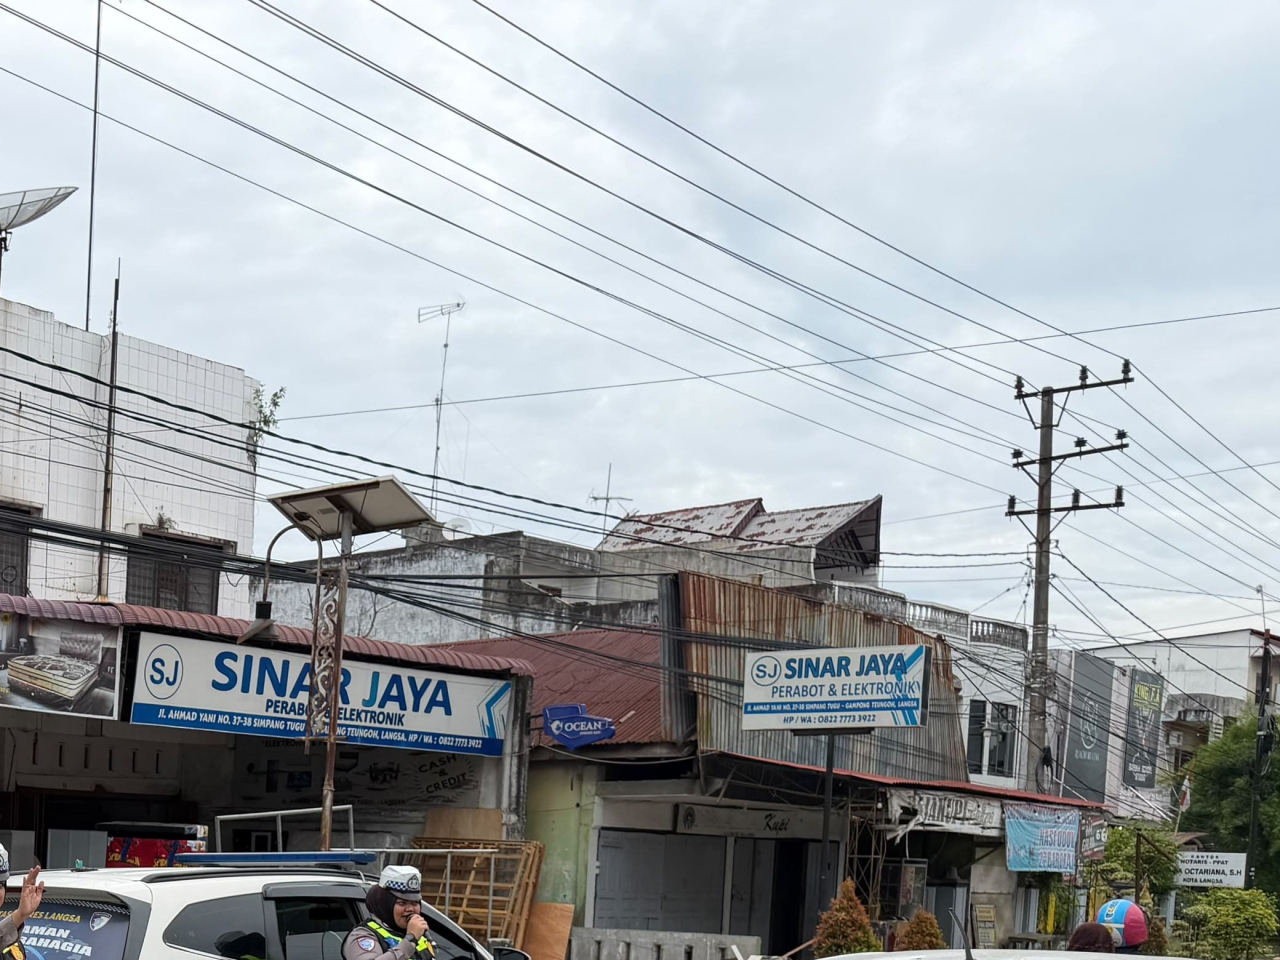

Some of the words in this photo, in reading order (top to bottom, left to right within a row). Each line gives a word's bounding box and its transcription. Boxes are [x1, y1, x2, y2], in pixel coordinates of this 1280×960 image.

[149, 657, 180, 687] SJ
[755, 663, 778, 679] SJ
[784, 655, 851, 680] SINAR
[855, 653, 908, 677] JAYA
[362, 671, 453, 716] JAYA
[771, 684, 825, 699] PERABOT
[828, 683, 837, 697] &
[841, 681, 916, 696] ELEKTRONIK
[168, 710, 197, 722] AHMAD
[199, 712, 216, 723] YANI
[217, 714, 231, 725] NO.
[232, 716, 252, 726] 37-38
[253, 718, 285, 730] SIMPANG
[286, 721, 306, 731] TUGU
[338, 707, 405, 726] ELEKTRONIK
[783, 716, 794, 724] HP
[800, 715, 812, 724] WA
[818, 715, 837, 723] 0822
[839, 714, 856, 723] 7773
[857, 714, 876, 722] 3922
[347, 727, 380, 740] TEUNGOH,
[423, 734, 433, 744] WA
[565, 721, 602, 732] OCEAN
[419, 753, 457, 773] CASH
[426, 773, 466, 793] CREDIT
[1184, 868, 1228, 876] OCTARIANA,
[44, 912, 81, 924] LANGSA
